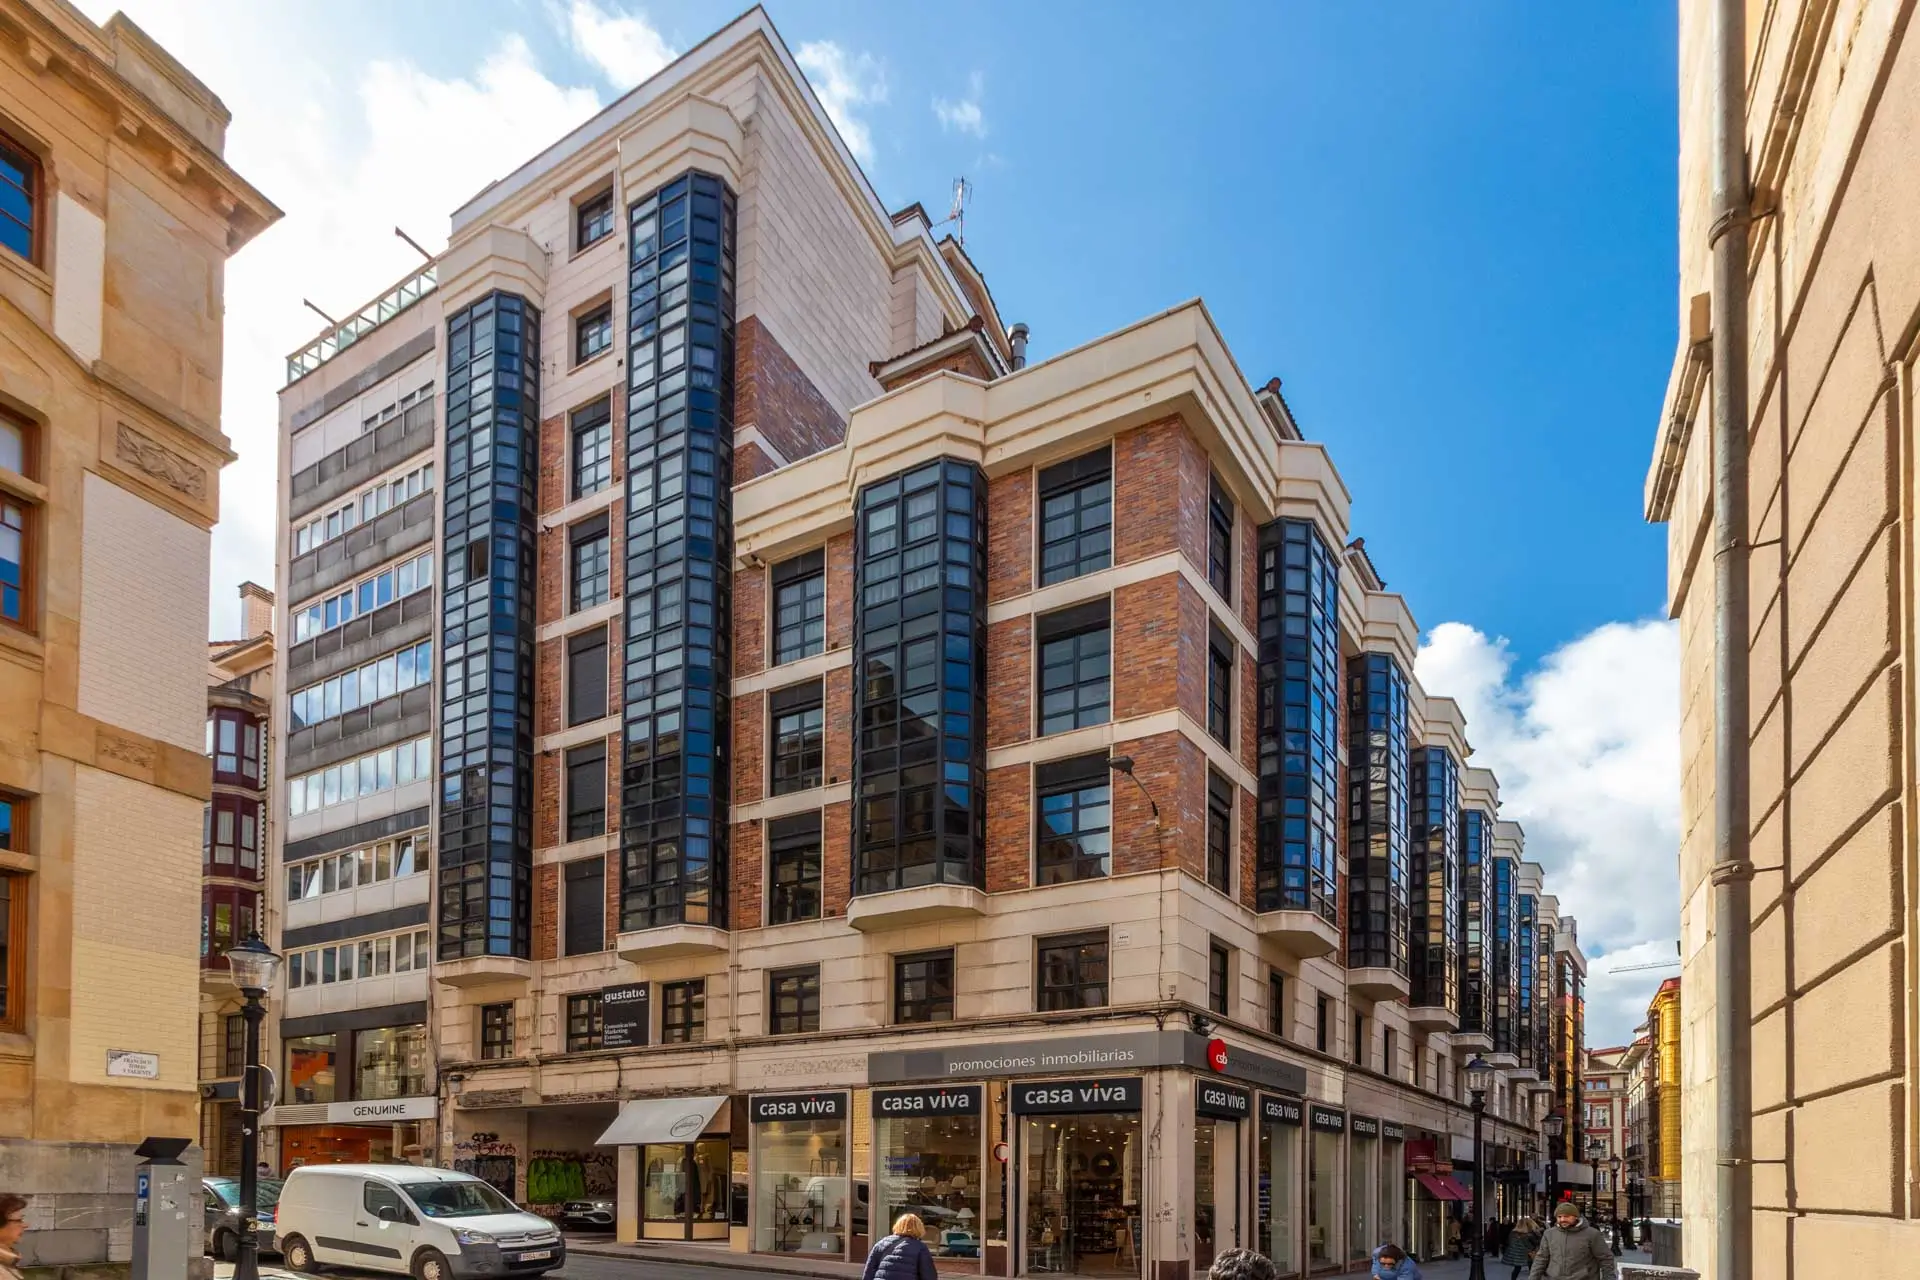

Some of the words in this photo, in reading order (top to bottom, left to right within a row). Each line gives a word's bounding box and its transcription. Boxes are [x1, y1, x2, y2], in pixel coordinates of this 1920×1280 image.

[604, 989, 646, 1003] gustatio
[949, 1056, 1036, 1074] promociones
[1041, 1048, 1135, 1066] inmobiliarias
[1215, 1051, 1228, 1065] csb
[881, 1096, 924, 1111] casa
[928, 1090, 969, 1109] viva
[1025, 1088, 1073, 1104] casa
[1079, 1082, 1126, 1103] viva
[1204, 1089, 1226, 1106] casa
[1227, 1091, 1246, 1110] viva
[759, 1101, 797, 1116] casa
[801, 1097, 836, 1114] viva
[1266, 1102, 1283, 1117] casa
[1284, 1103, 1299, 1120] viva
[1315, 1112, 1329, 1125] casa
[1329, 1114, 1342, 1128] viva
[1354, 1120, 1365, 1132] casa
[1365, 1122, 1376, 1134] viva
[139, 1178, 149, 1195] P
